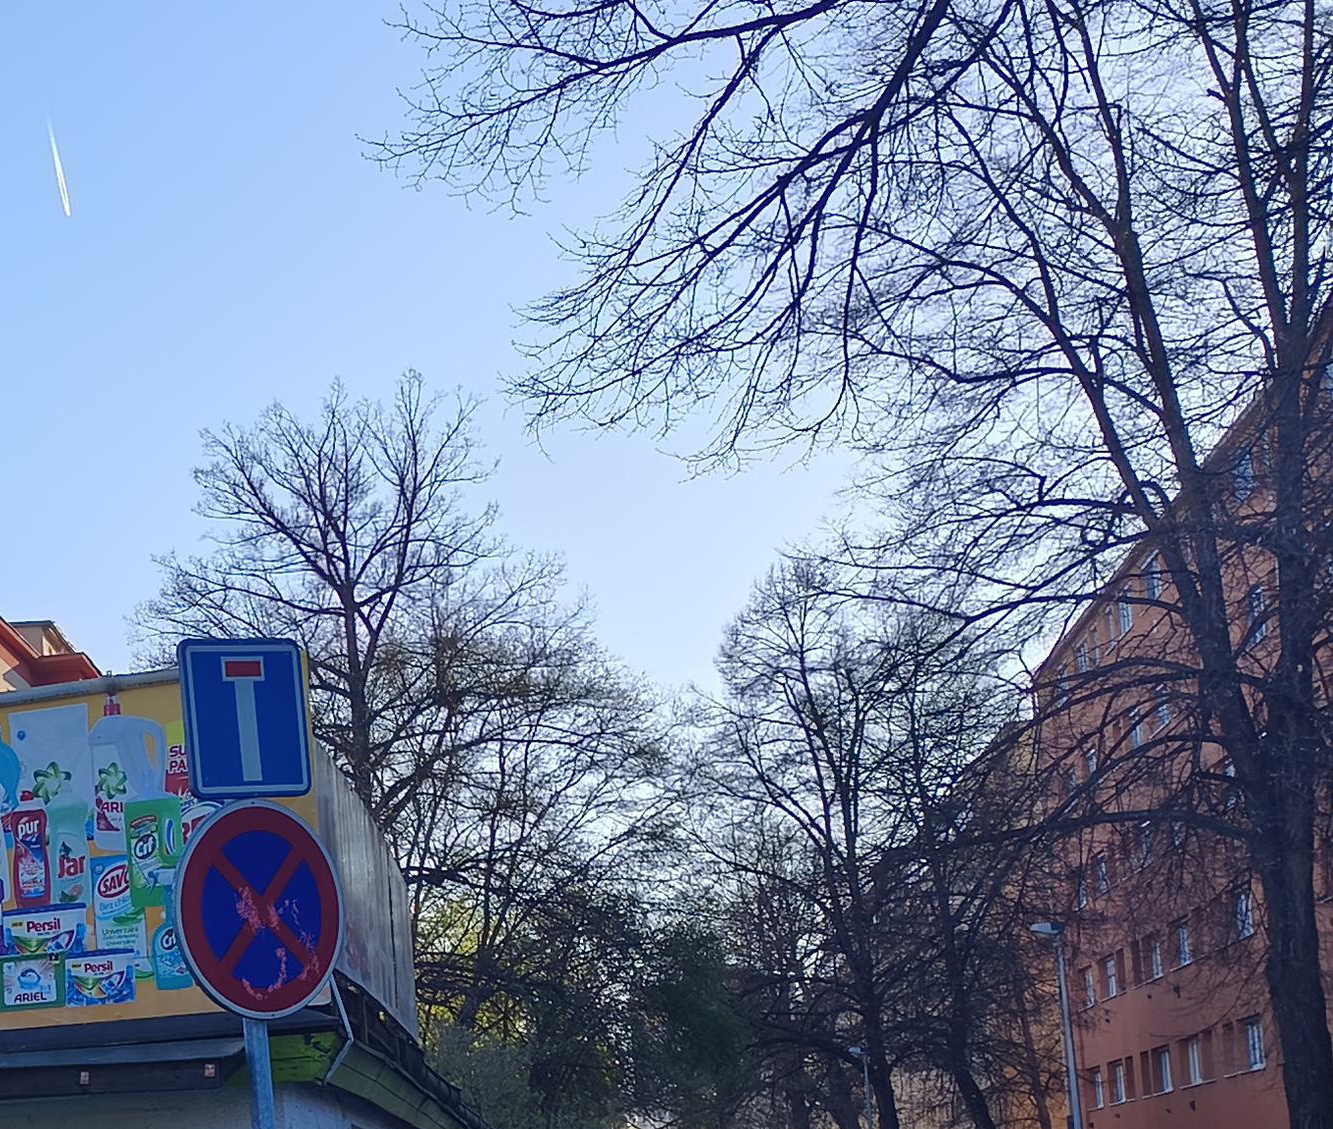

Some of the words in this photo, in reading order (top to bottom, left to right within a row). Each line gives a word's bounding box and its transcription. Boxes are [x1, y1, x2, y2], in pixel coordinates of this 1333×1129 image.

[101, 801, 124, 814] ARI
[18, 819, 40, 840] pur
[58, 854, 86, 878] Jar
[27, 917, 61, 933] Persil
[84, 960, 114, 974] Persil
[14, 991, 47, 1003] ARIEL
